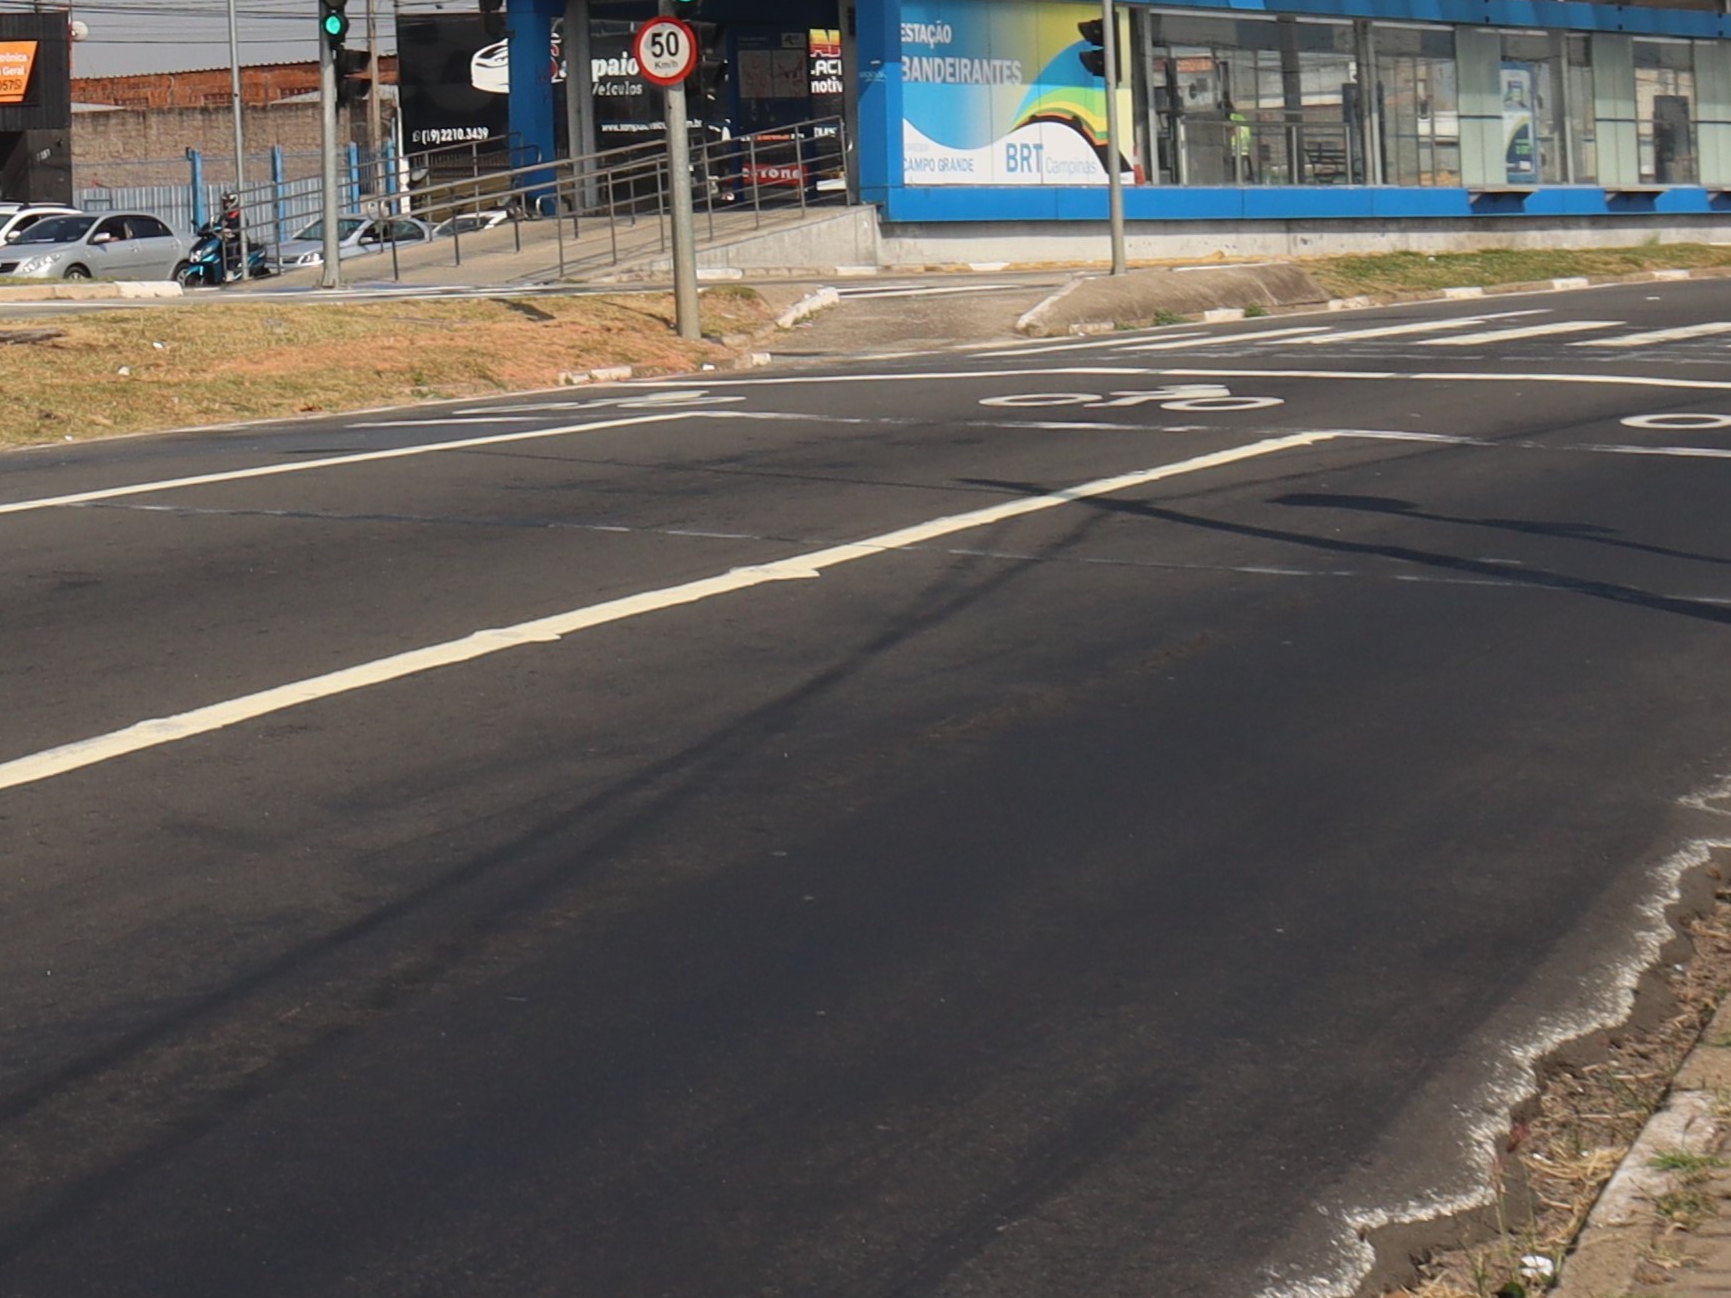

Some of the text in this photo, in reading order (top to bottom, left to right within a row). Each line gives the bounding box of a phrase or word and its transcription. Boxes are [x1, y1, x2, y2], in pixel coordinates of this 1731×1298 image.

[650, 31, 679, 58] 50
[901, 20, 952, 49] ESTAÇÃO
[2, 65, 25, 76] Geral
[903, 157, 973, 172] CAMPO GRANDE
[1006, 143, 1097, 176] BRT Campinas
